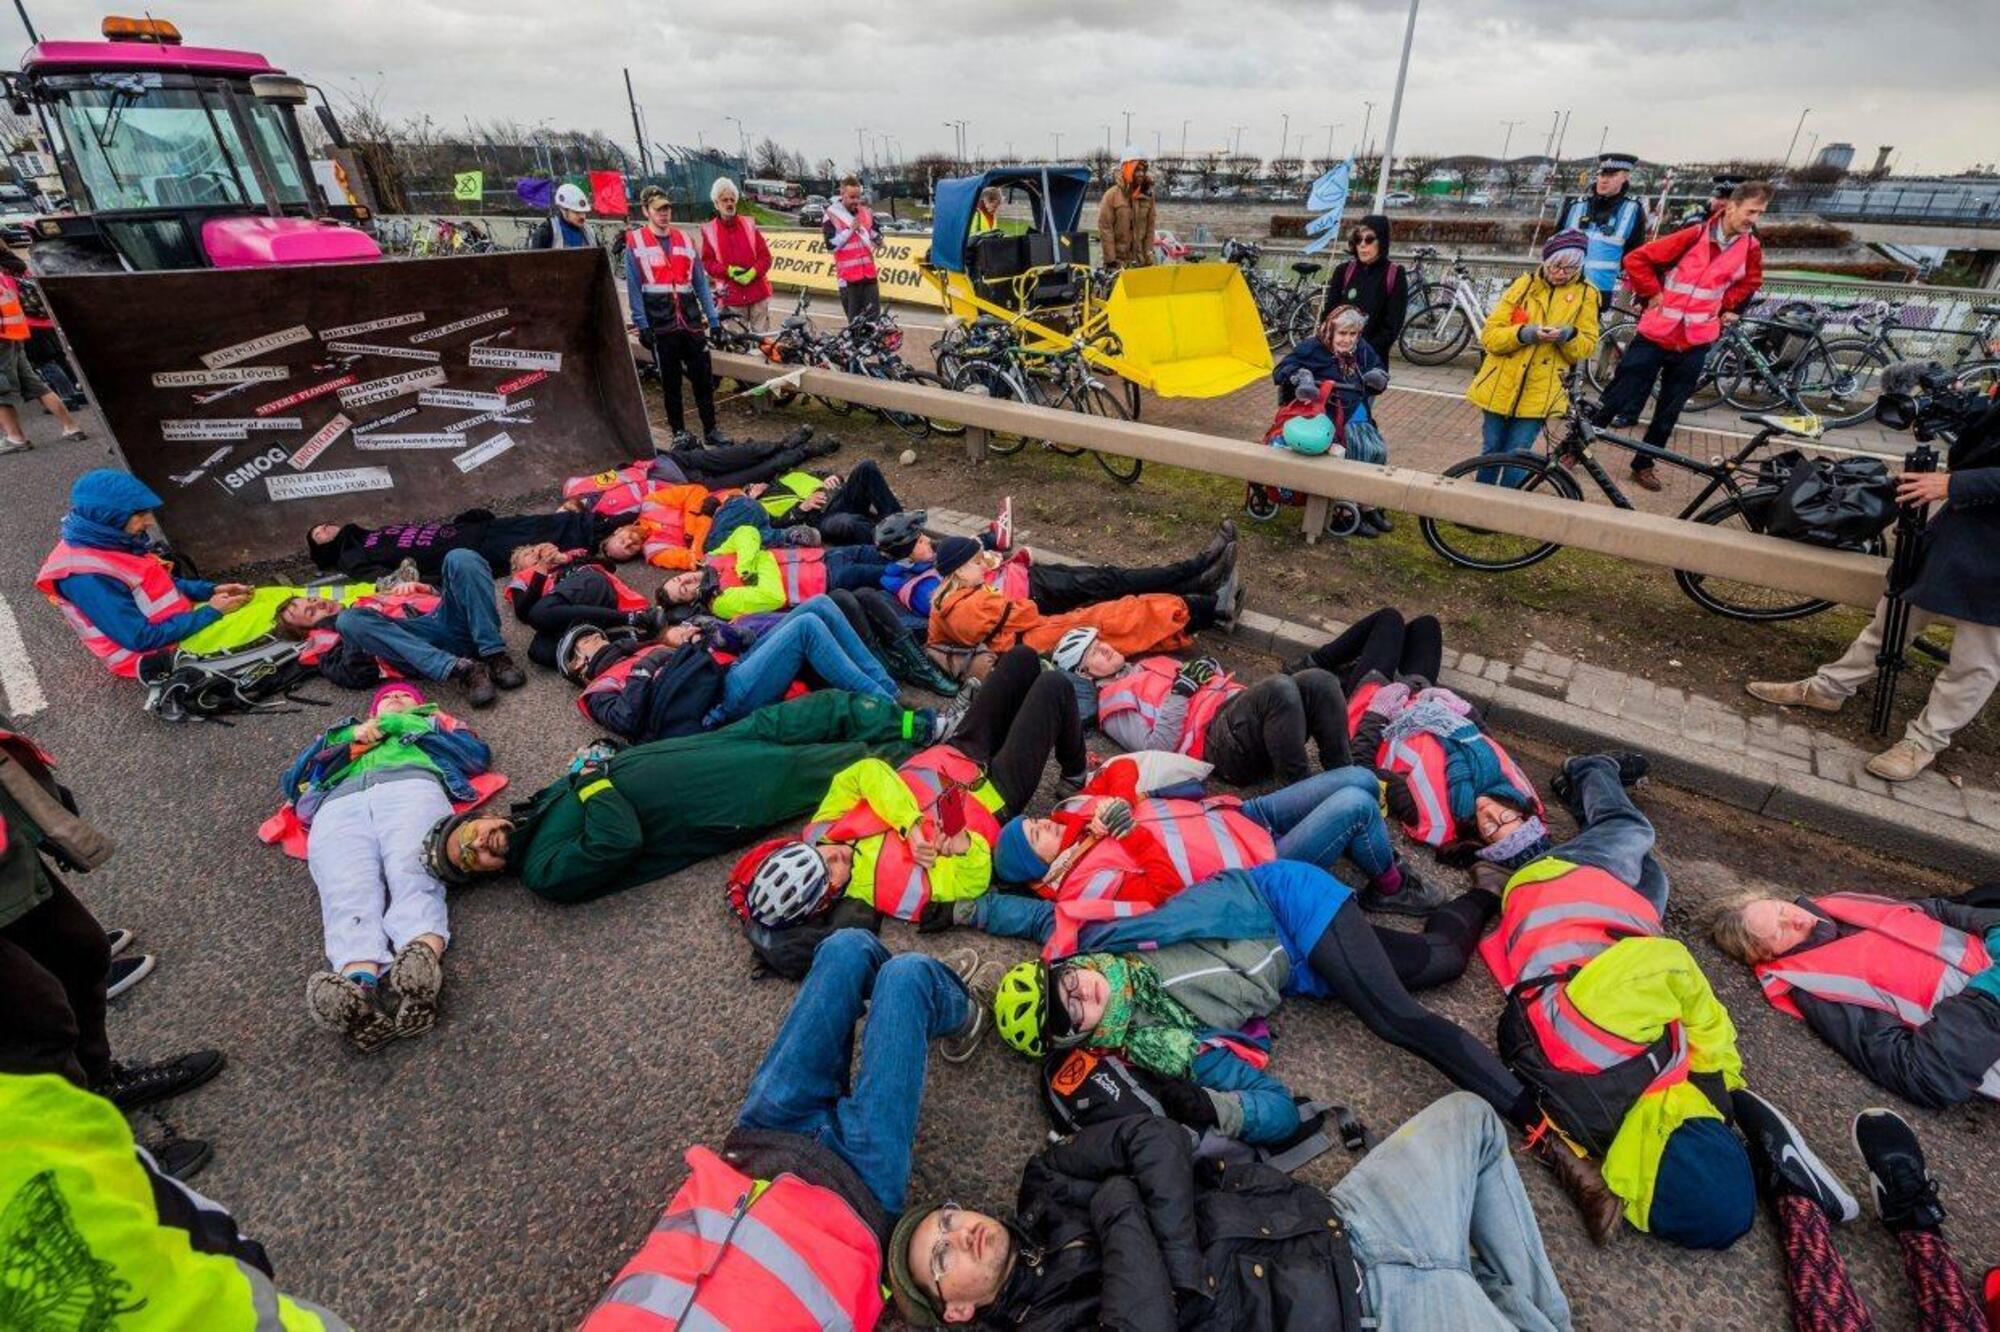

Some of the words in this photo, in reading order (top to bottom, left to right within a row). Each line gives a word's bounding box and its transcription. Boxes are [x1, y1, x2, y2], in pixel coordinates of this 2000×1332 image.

[211, 350, 235, 365] AIR
[235, 330, 306, 357] POLLUTION
[471, 348, 511, 357] MISSED
[512, 351, 556, 360] CLIMATE
[470, 357, 517, 367] TARGETS
[155, 373, 206, 385] Rising
[211, 371, 237, 381] sea
[241, 367, 285, 380] levels
[338, 380, 390, 399] BILLIONS
[391, 375, 406, 387] OF
[406, 368, 438, 383] LIVES
[256, 395, 299, 417] SEVERE
[299, 376, 352, 402] FLOODING
[344, 388, 400, 409] AFFECTED
[163, 421, 201, 430] Record
[205, 420, 244, 430] number
[261, 420, 300, 429] extreme
[166, 430, 207, 439] weather
[212, 430, 245, 438] events
[293, 418, 346, 467] DROUGHTS
[224, 447, 288, 488] SMOG
[271, 473, 314, 486] LOWER
[315, 470, 357, 482] LIVING
[273, 482, 344, 498] STANDARDS
[346, 480, 368, 490] FOR
[370, 477, 390, 489] ALL
